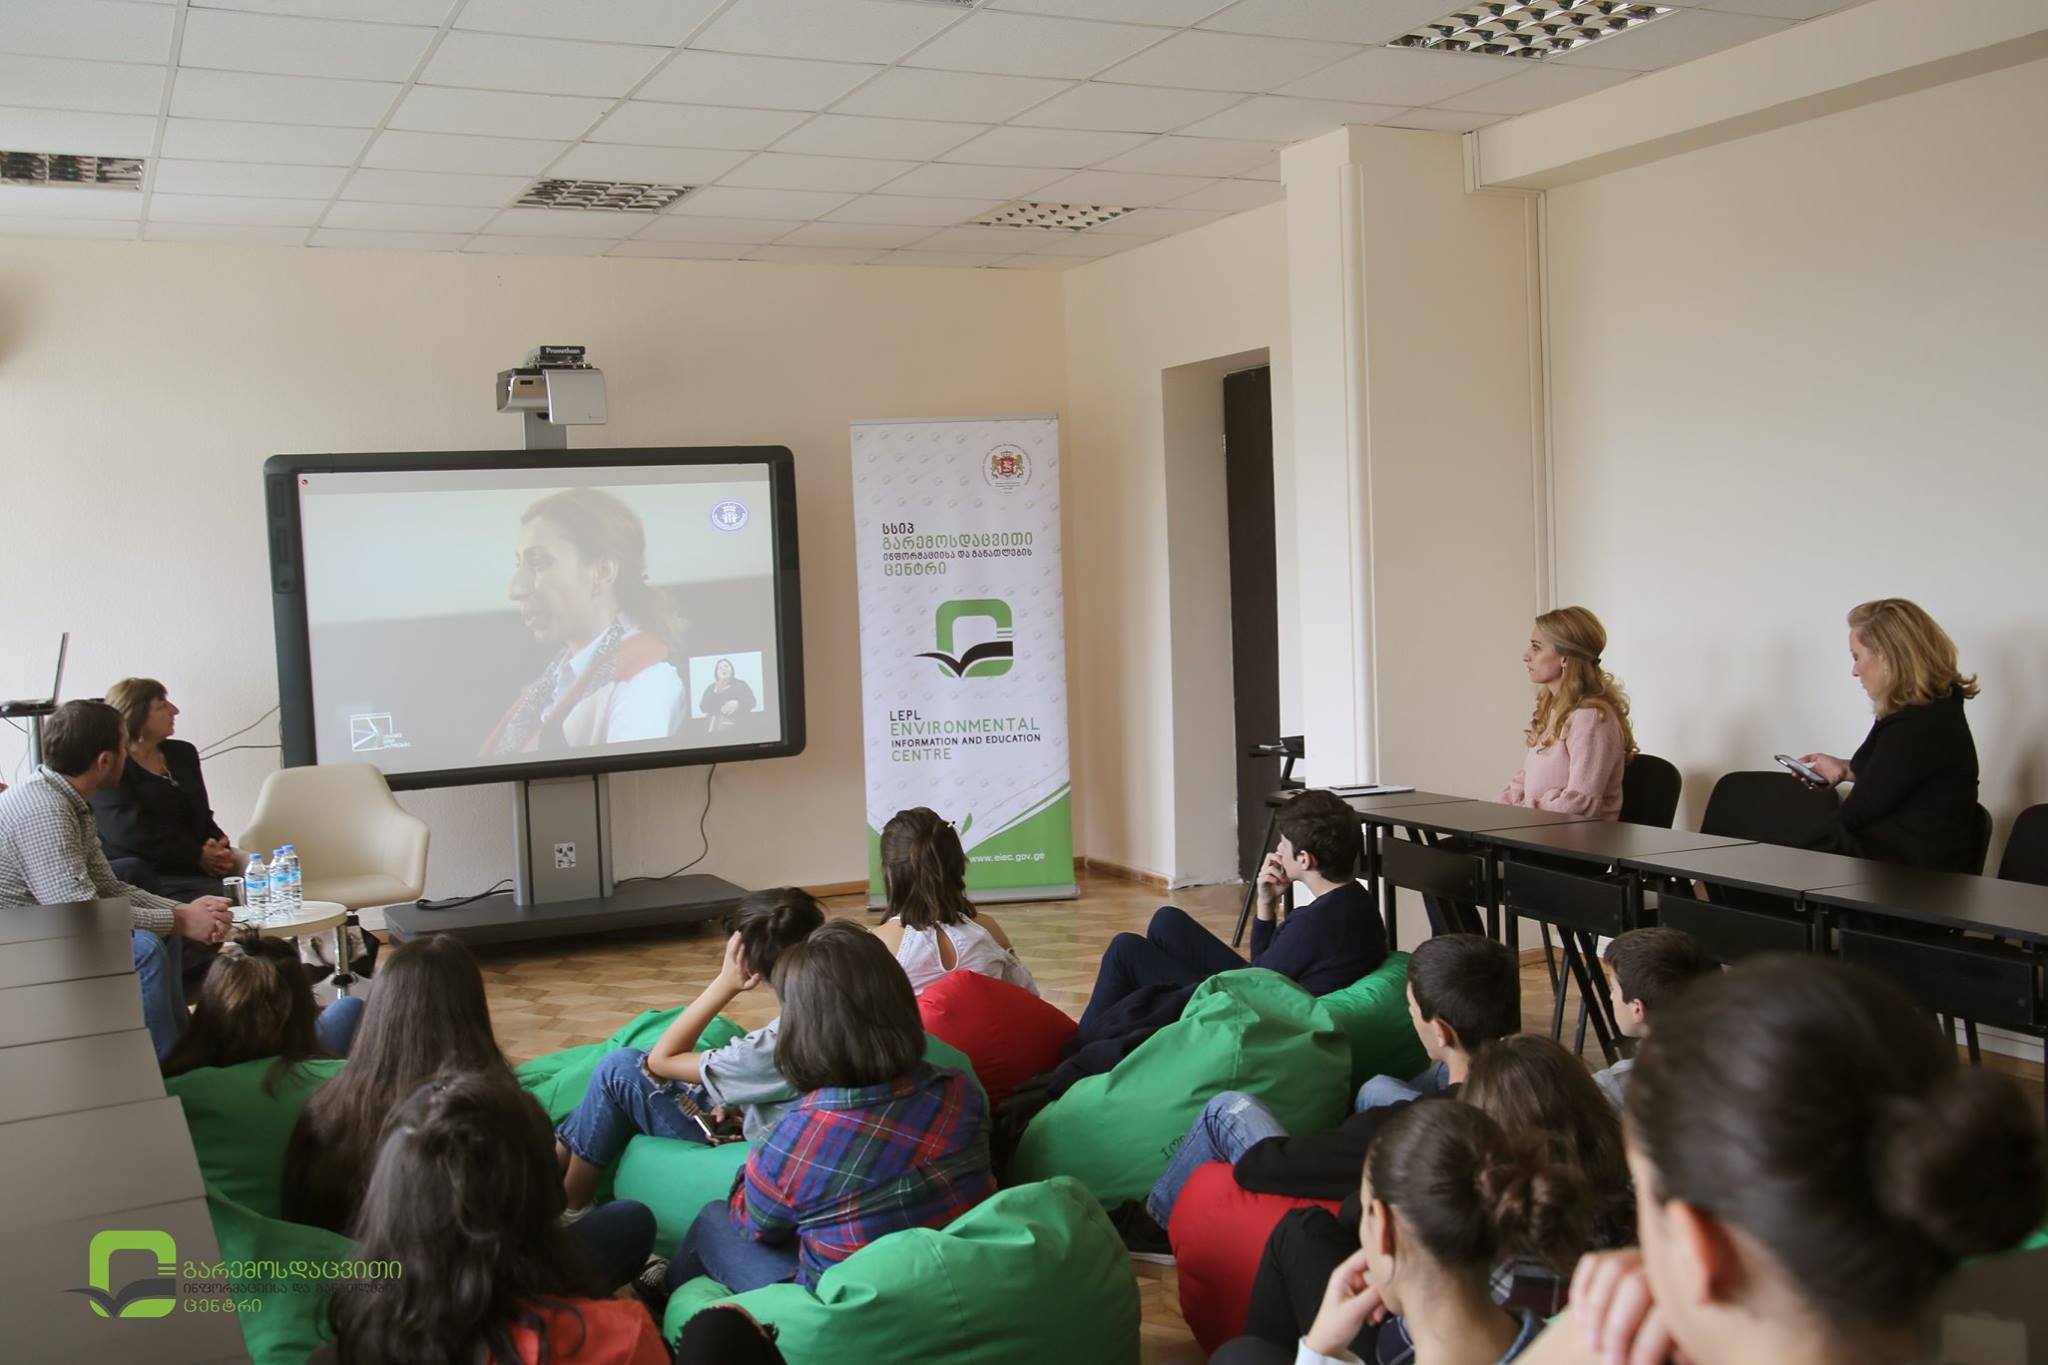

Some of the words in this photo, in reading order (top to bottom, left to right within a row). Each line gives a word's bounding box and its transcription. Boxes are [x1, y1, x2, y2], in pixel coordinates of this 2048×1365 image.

[882, 522, 915, 535] სსიპ
[882, 531, 1033, 550] გარემოსდაცვითი
[883, 551, 955, 561] ინფორმაციისა
[957, 549, 970, 559] და
[972, 548, 1033, 558] განათლების
[884, 561, 947, 576] ცენტრი
[889, 709, 921, 722] LEPL
[890, 717, 1041, 736] ENVIRONMENTAL
[891, 738, 958, 748] INFORMATION
[962, 736, 983, 745] AND
[986, 734, 1041, 744] EDUCATION
[891, 748, 952, 762] CENTRE
[968, 852, 1046, 863] www.eiec.gov.ge
